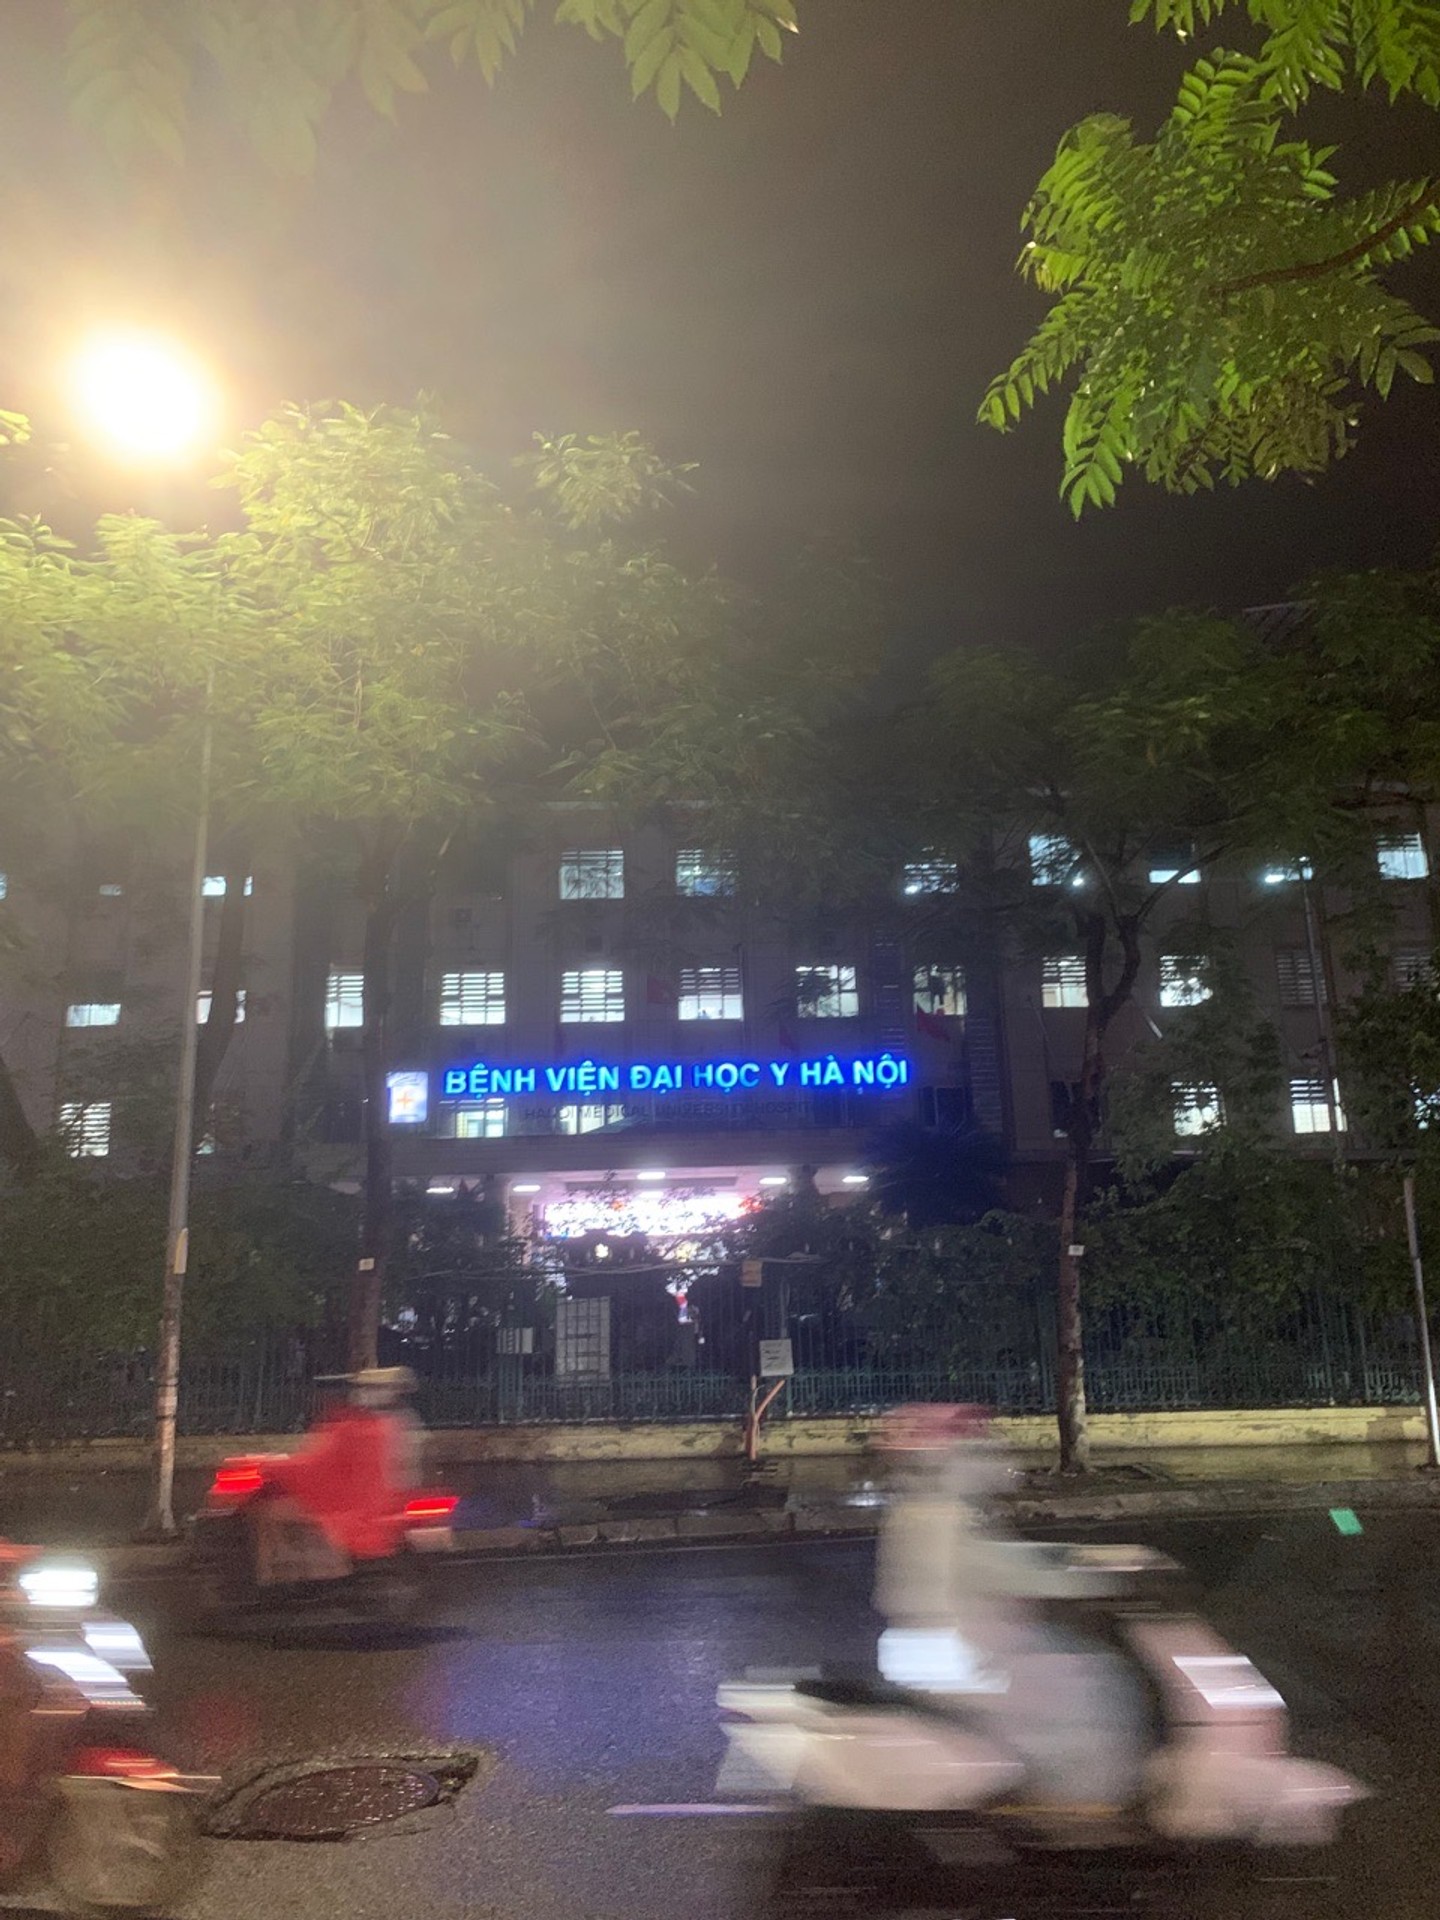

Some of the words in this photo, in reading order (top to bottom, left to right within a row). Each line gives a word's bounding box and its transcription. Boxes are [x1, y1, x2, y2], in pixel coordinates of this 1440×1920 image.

[445, 1062, 536, 1099] BỆNH
[546, 1060, 620, 1096] VIỆN
[630, 1064, 683, 1095] ĐẠI
[693, 1062, 761, 1093] HỌC
[769, 1061, 790, 1087] Y
[800, 1054, 845, 1086] HÀ
[852, 1052, 908, 1090] NỘI
